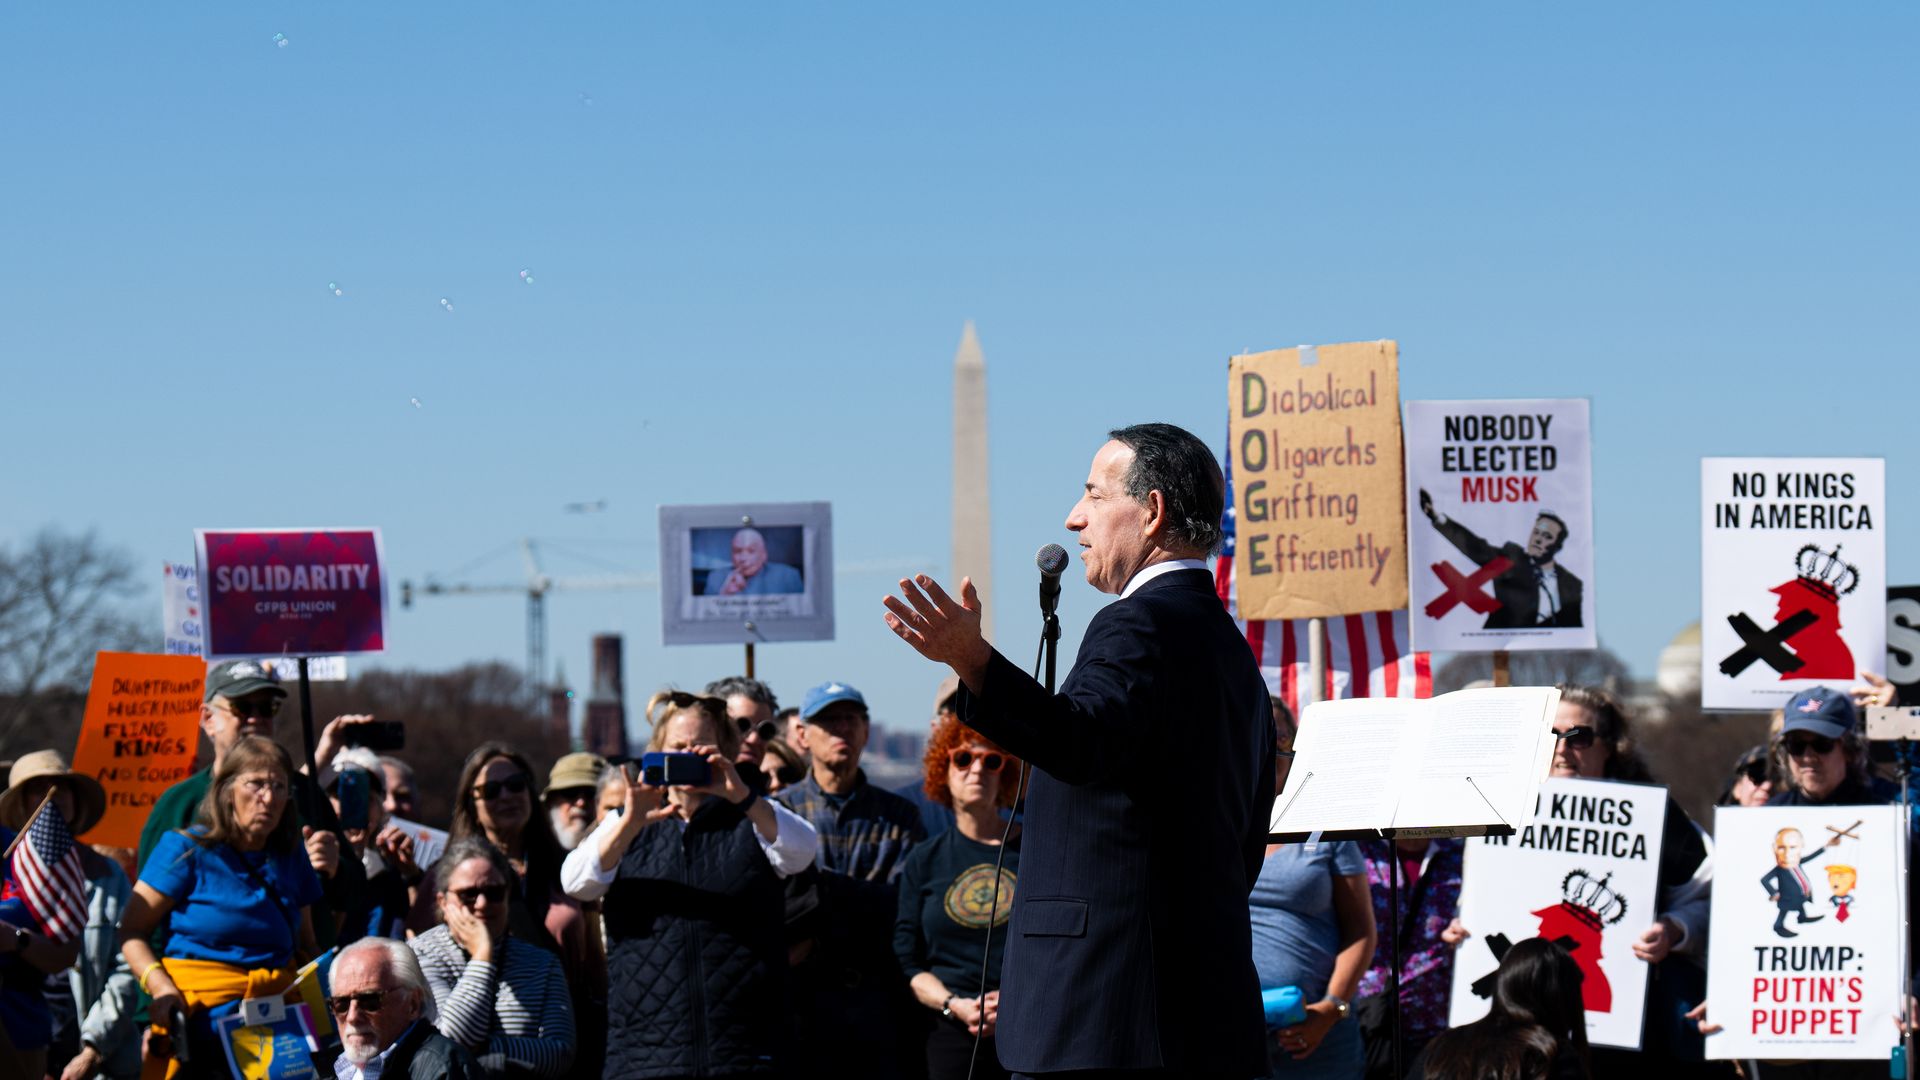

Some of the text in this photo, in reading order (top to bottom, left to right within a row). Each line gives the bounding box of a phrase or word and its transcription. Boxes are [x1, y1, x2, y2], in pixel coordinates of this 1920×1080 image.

[1241, 371, 1376, 418] Diabolical
[1444, 414, 1553, 441] NOBODY
[1241, 426, 1377, 479] Oligarchs
[1442, 446, 1557, 472] ELECTED
[1462, 477, 1538, 503] MUSK
[1732, 472, 1855, 498] NO KINGS
[1244, 480, 1358, 526] Grifting
[1715, 504, 1873, 530] IN AMERICA
[1248, 532, 1391, 586] Efficiently
[216, 563, 370, 592] SOLIDARITY
[255, 601, 336, 614] CFPB UNION
[104, 721, 168, 739] FLING
[114, 738, 187, 758] KINGS
[97, 767, 132, 783] NO
[1551, 793, 1634, 826] KINGS
[1519, 824, 1647, 860] AMERICA
[1754, 946, 1864, 971] TRUMP:
[1753, 977, 1863, 1003] PUTIN'S
[1751, 1009, 1863, 1035] PUPPET
